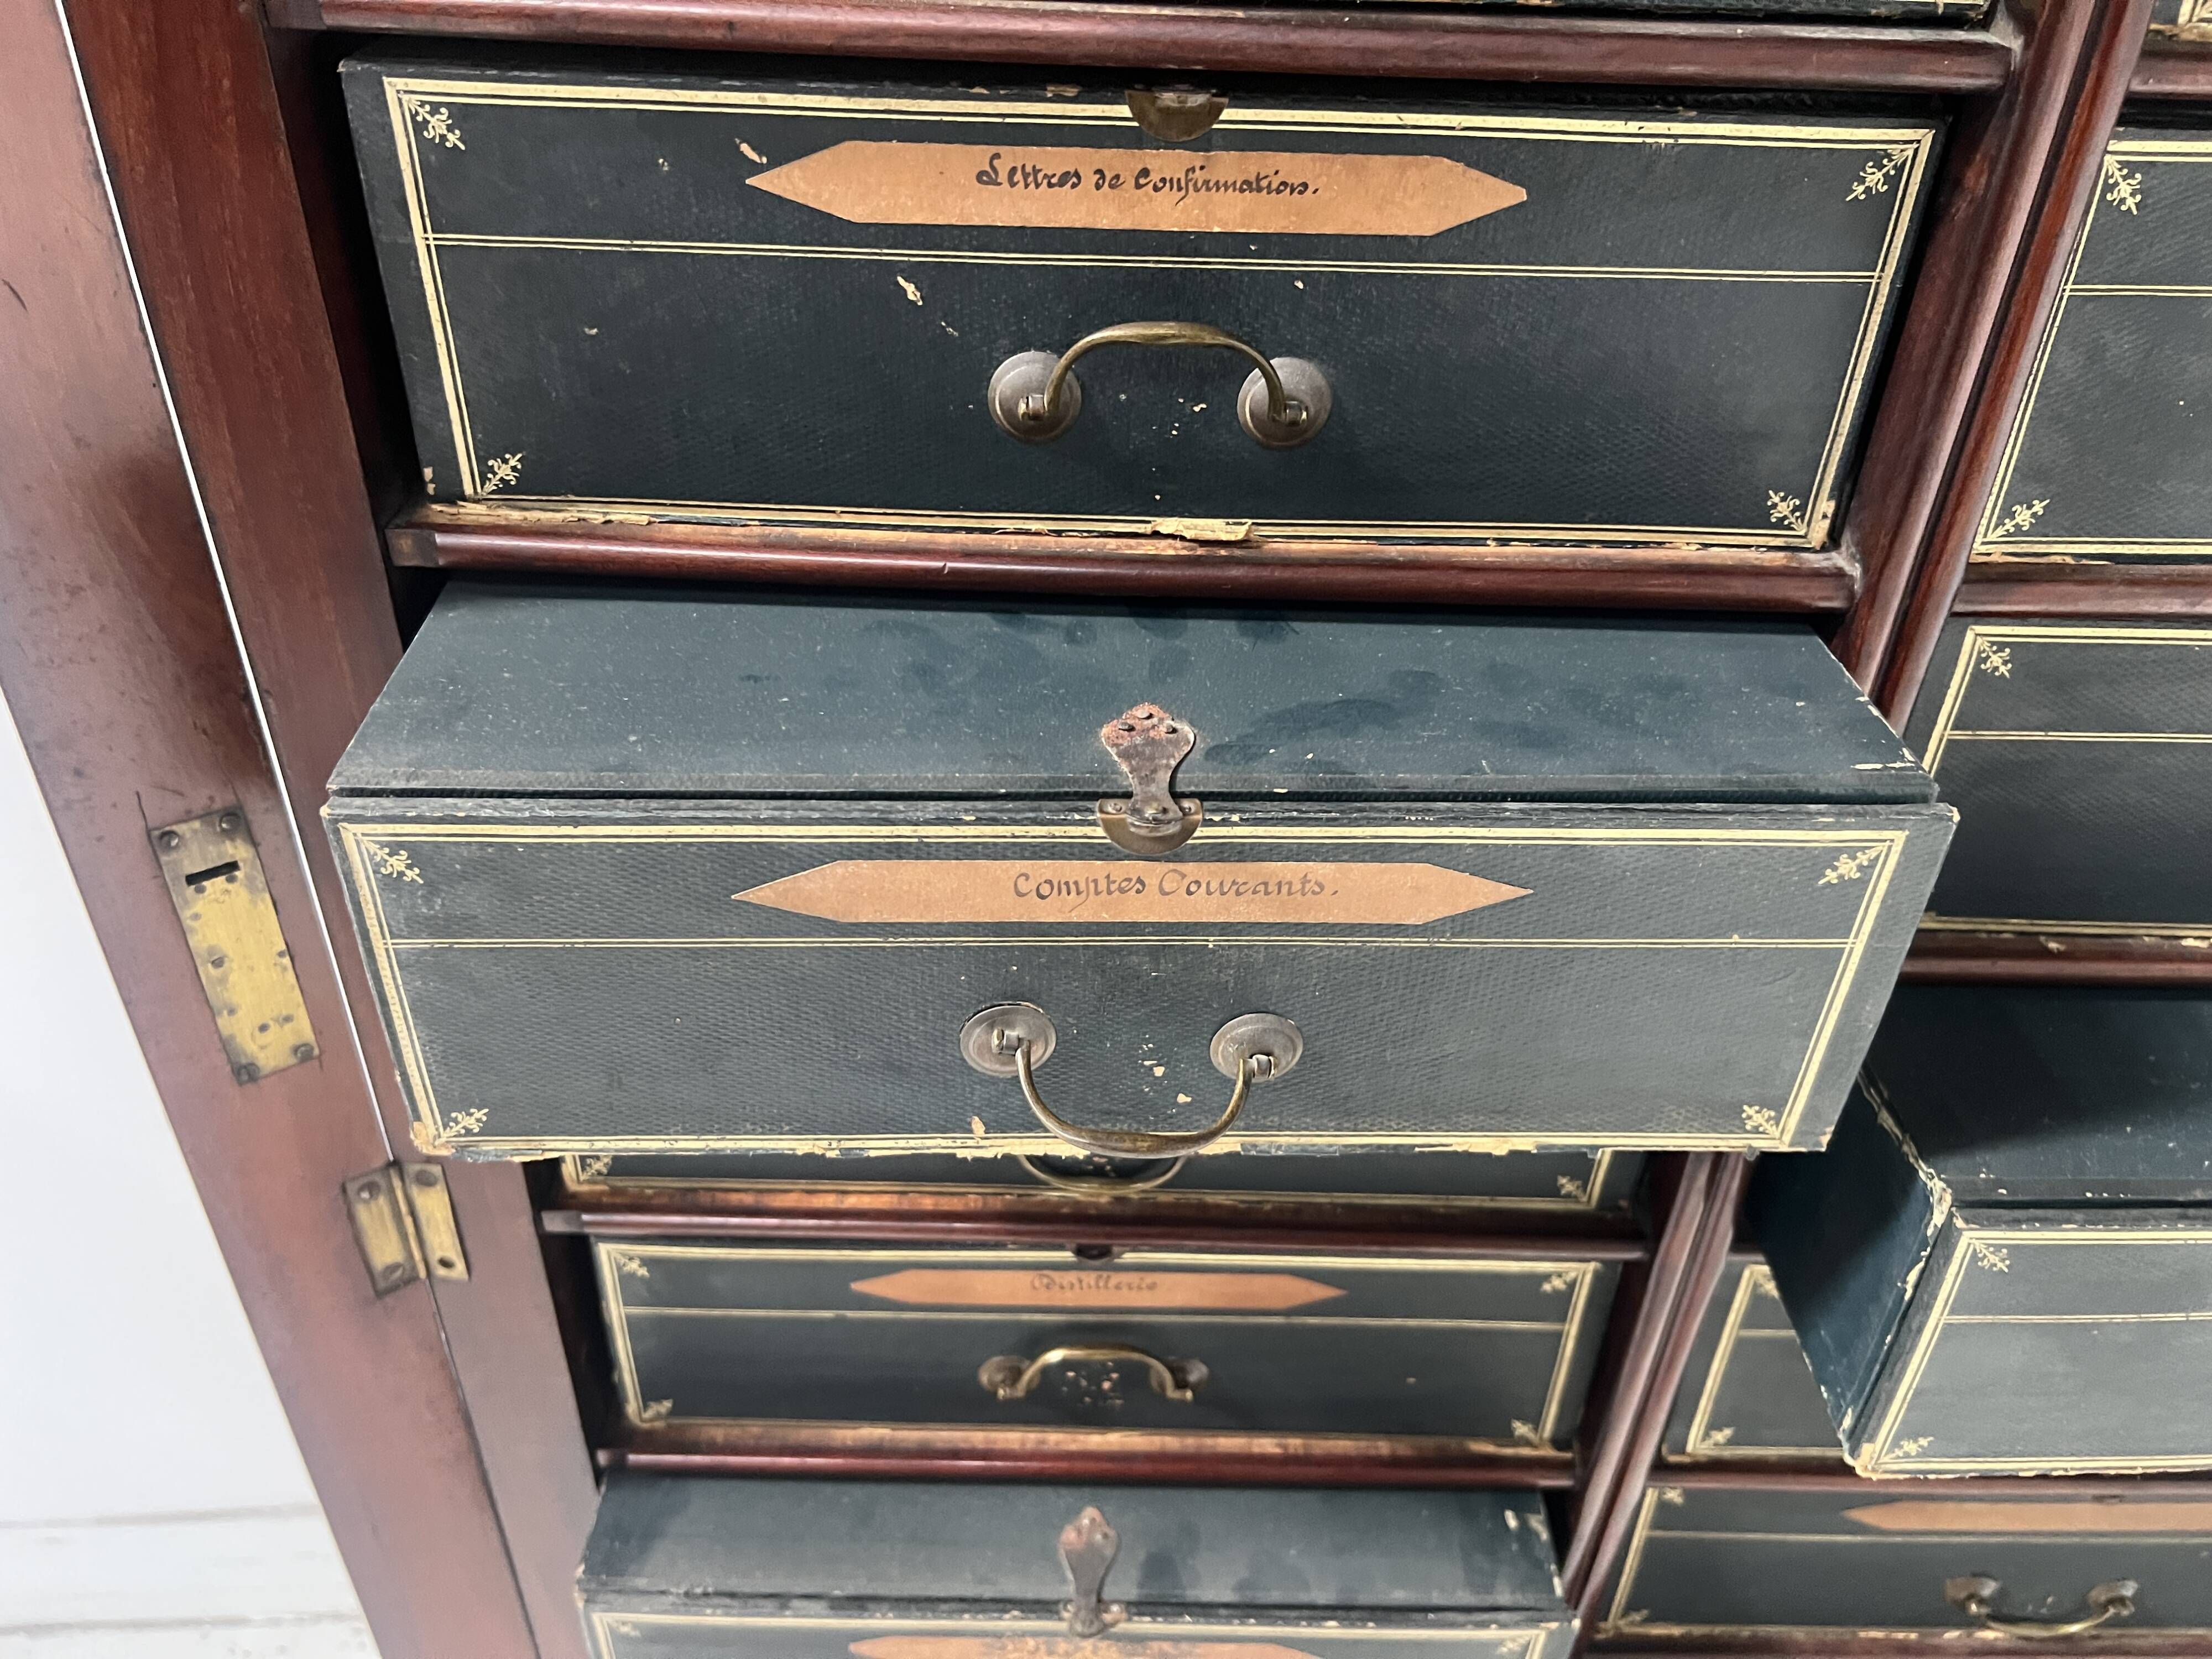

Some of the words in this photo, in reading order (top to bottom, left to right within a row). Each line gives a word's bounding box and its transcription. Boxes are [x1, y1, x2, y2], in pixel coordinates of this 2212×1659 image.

[975, 152, 1082, 190] Lettres
[1093, 168, 1126, 191] de
[1013, 872, 1146, 914] Comptes
